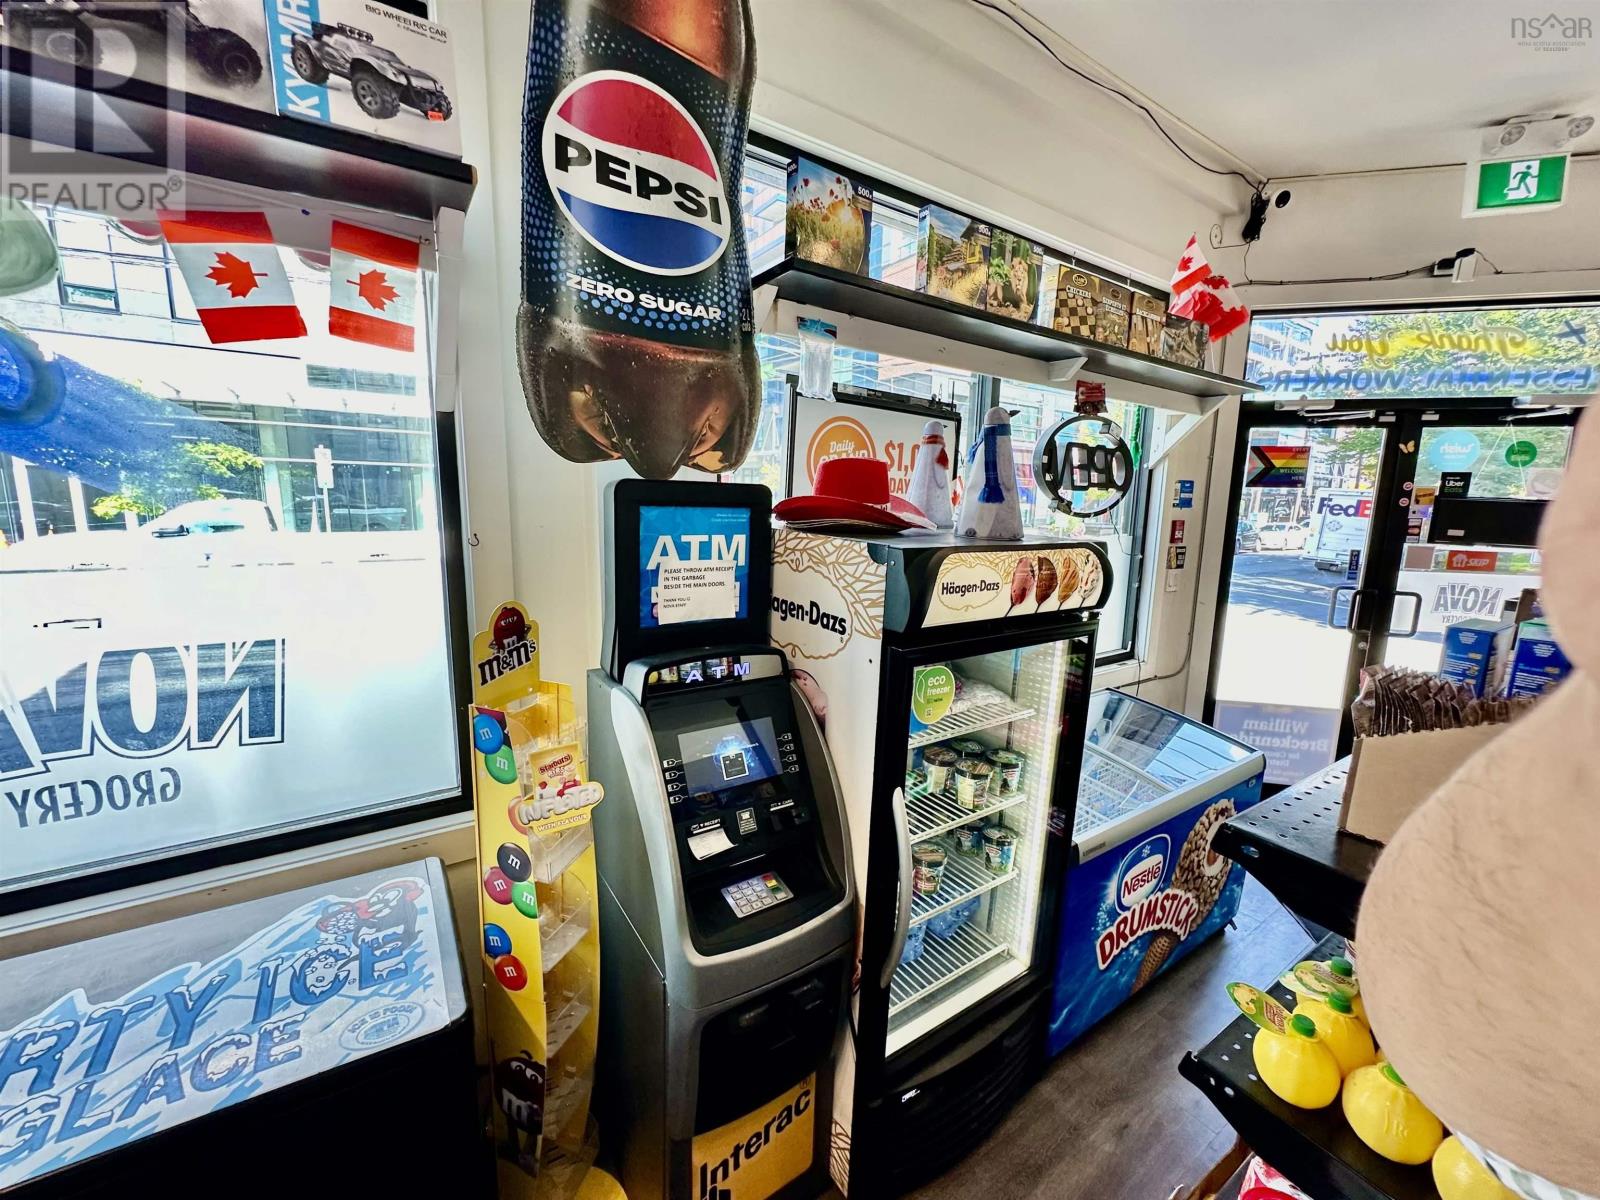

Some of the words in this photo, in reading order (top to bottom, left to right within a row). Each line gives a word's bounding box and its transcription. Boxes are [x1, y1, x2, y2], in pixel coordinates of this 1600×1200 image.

[365, 4, 381, 16] BIG
[429, 26, 447, 39] CAR
[554, 132, 724, 226] PEPSI
[566, 272, 635, 304] ZERO
[638, 292, 723, 321] SUGAR
[830, 440, 854, 454] Daily
[1317, 496, 1373, 519] FedE
[646, 534, 747, 571] ATM
[1467, 558, 1490, 567] SKIP
[770, 594, 847, 636] agen-Dazs
[927, 675, 946, 687] eco
[927, 686, 951, 697] freezer
[1099, 892, 1198, 967] DRUMSTICK
[251, 927, 409, 1024] ICE
[0, 1012, 306, 1164] GLACE
[700, 1088, 811, 1200] Interac
